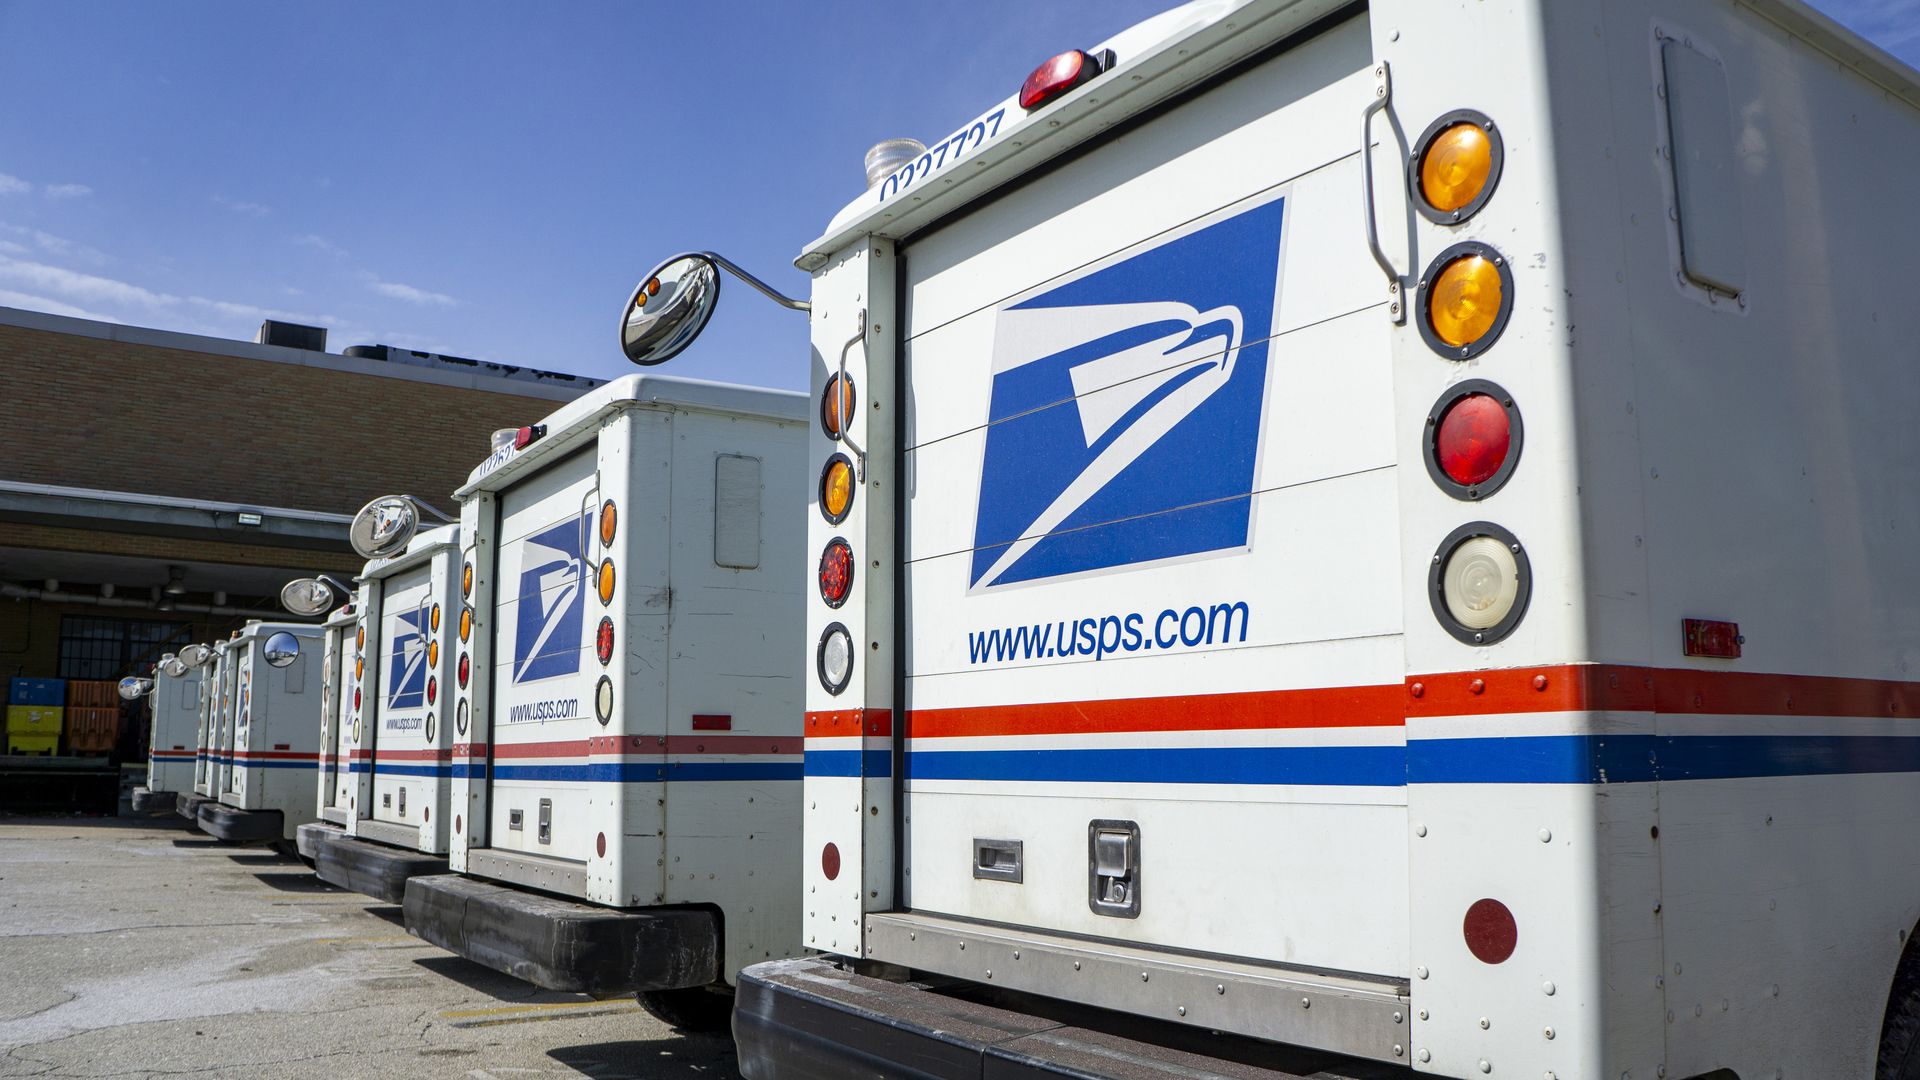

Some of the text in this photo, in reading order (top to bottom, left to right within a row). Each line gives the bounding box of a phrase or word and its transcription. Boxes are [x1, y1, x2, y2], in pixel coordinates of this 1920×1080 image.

[879, 107, 1006, 203] 0227727
[968, 600, 1250, 664] www.usps.com
[510, 698, 578, 726] www.usps.com
